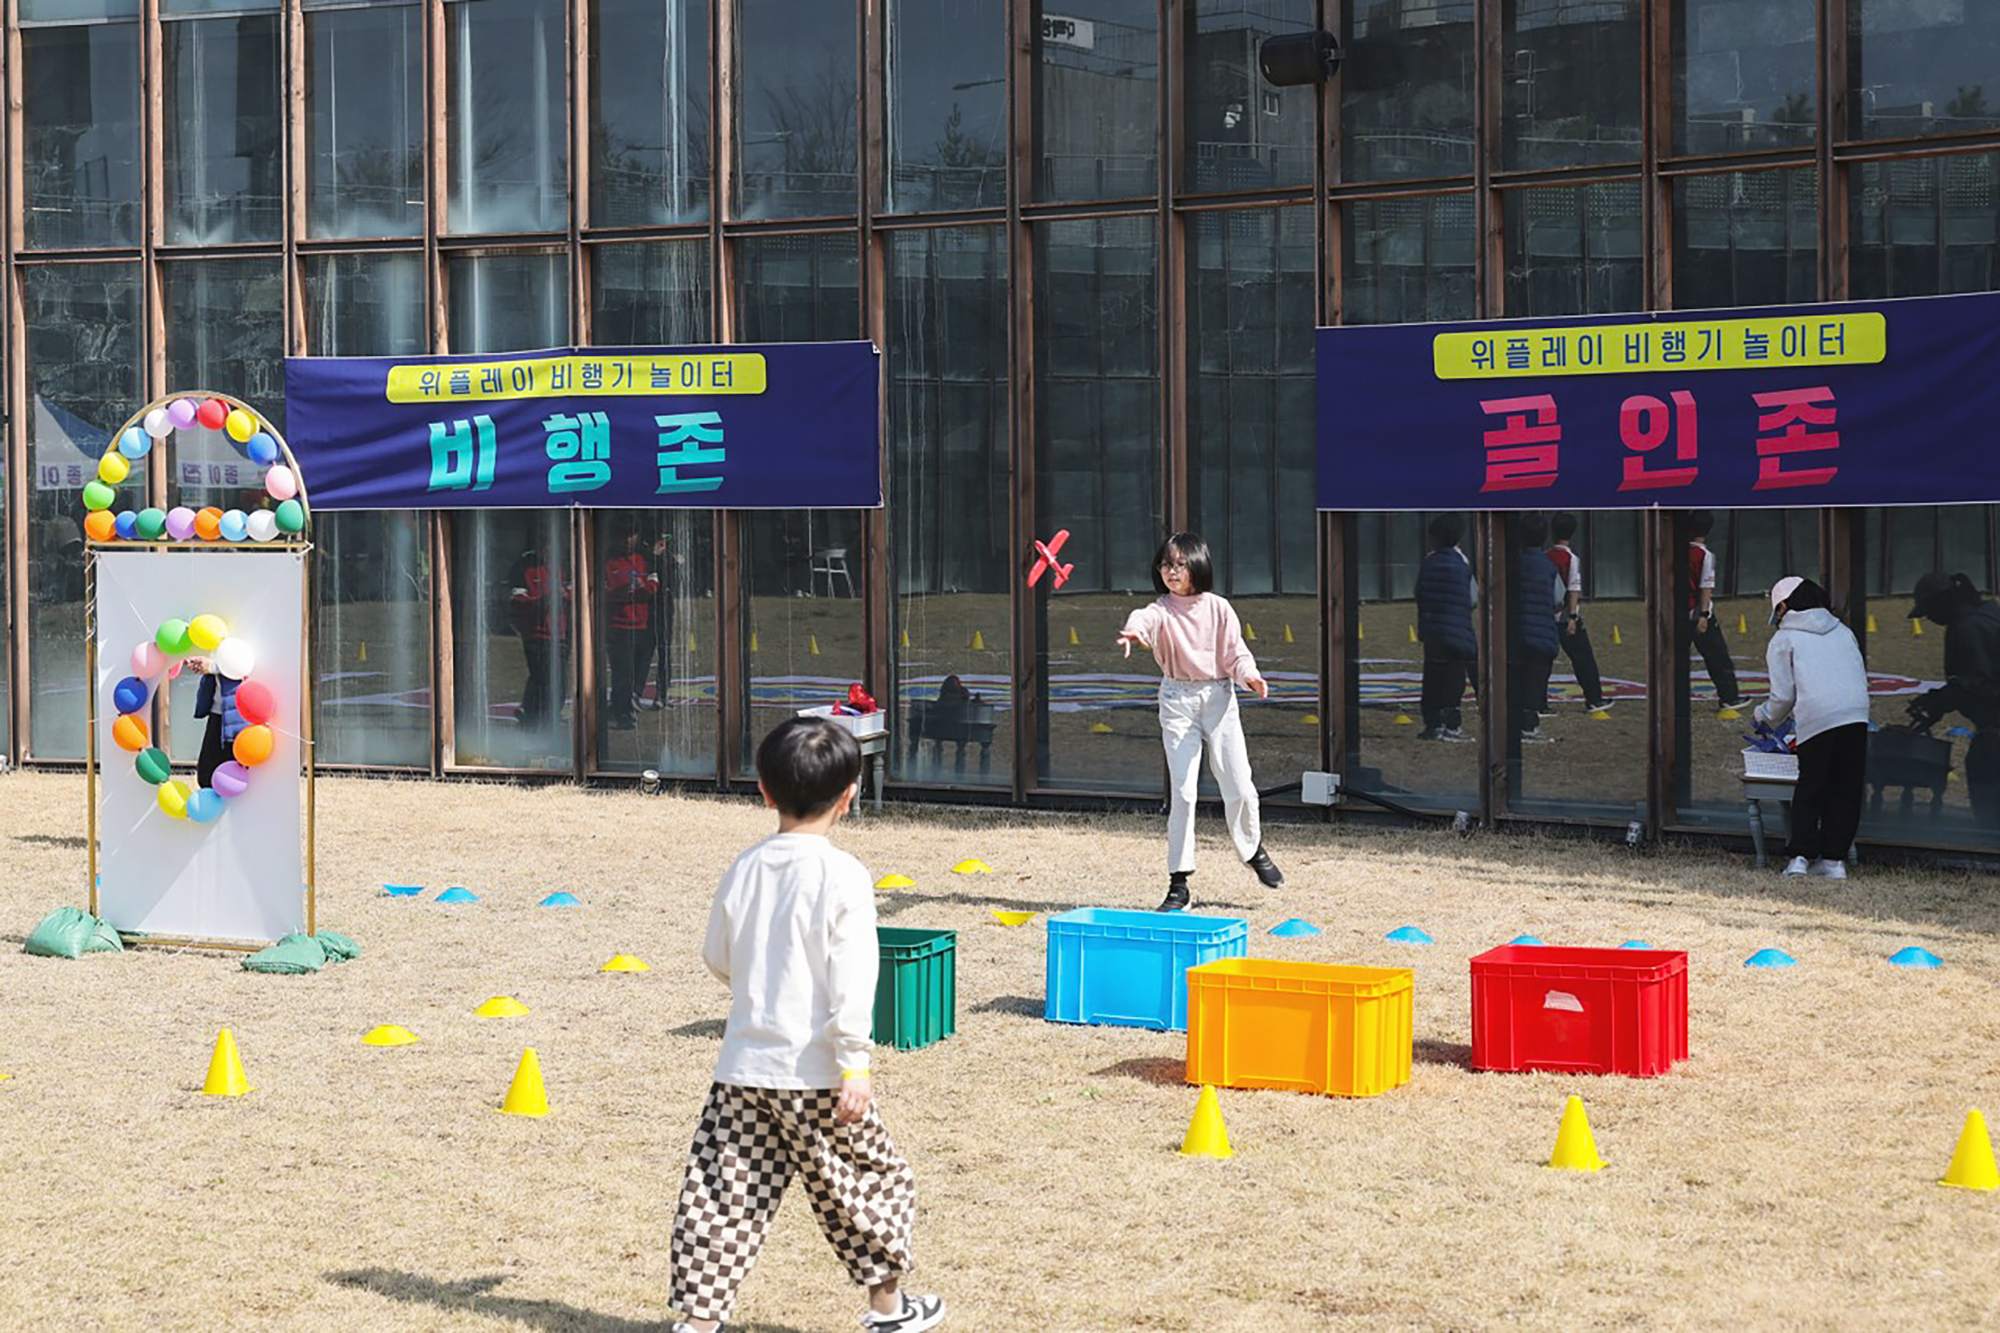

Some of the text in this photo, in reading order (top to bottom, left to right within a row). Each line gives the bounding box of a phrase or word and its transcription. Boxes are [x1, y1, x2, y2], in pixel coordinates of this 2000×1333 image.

[418, 360, 733, 396] 위플레이 비행기 놀이터
[1470, 322, 1845, 370] 위플레이 비행기 놀이터
[427, 411, 726, 494] 비행존
[1479, 386, 1841, 491] 골인존
